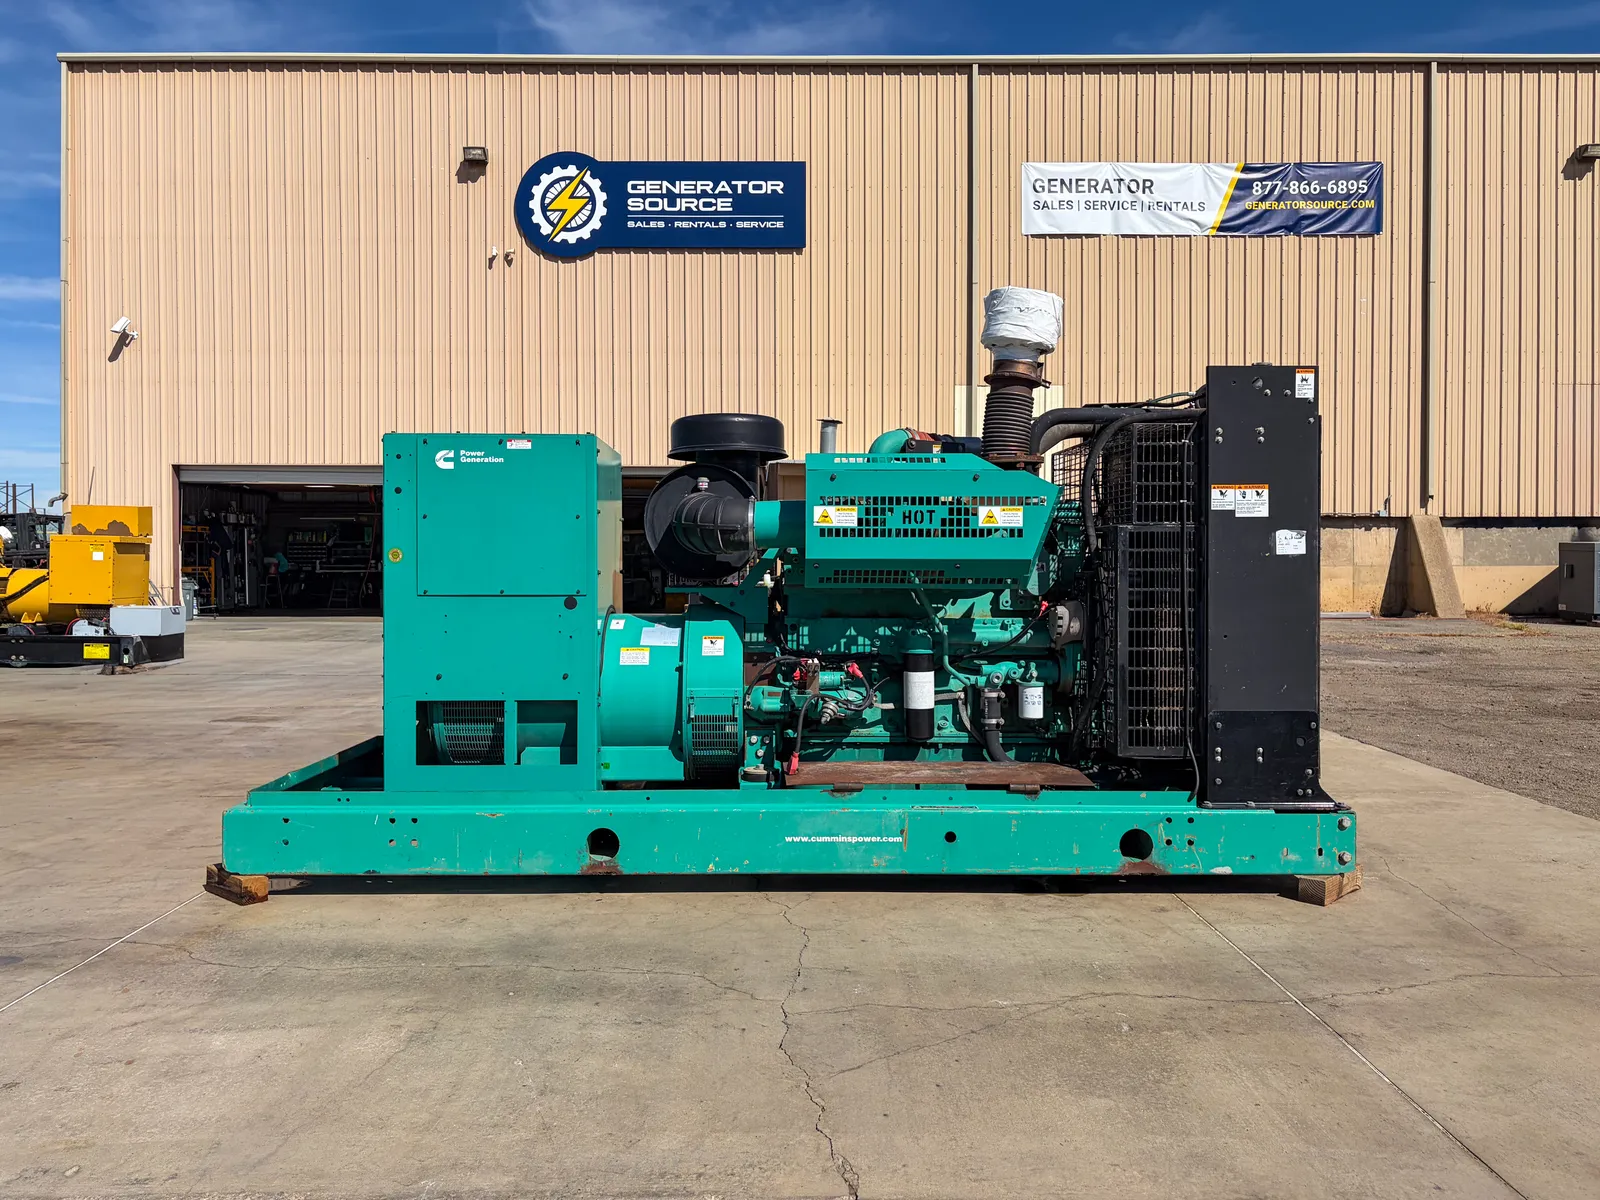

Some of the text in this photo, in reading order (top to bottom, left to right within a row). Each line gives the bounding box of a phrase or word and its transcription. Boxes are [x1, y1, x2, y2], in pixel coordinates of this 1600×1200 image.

[627, 180, 785, 194] GENERATOR
[1032, 178, 1155, 195] GENERATOR
[1252, 179, 1368, 196] 877-866-6895
[627, 197, 733, 212] SOURCE
[1032, 200, 1206, 212] SALES SERVICE RENTALS
[1245, 199, 1375, 210] GENERATORSOURCE.COM
[902, 509, 936, 525] HOT
[785, 835, 902, 843] www.cumminspower.com
